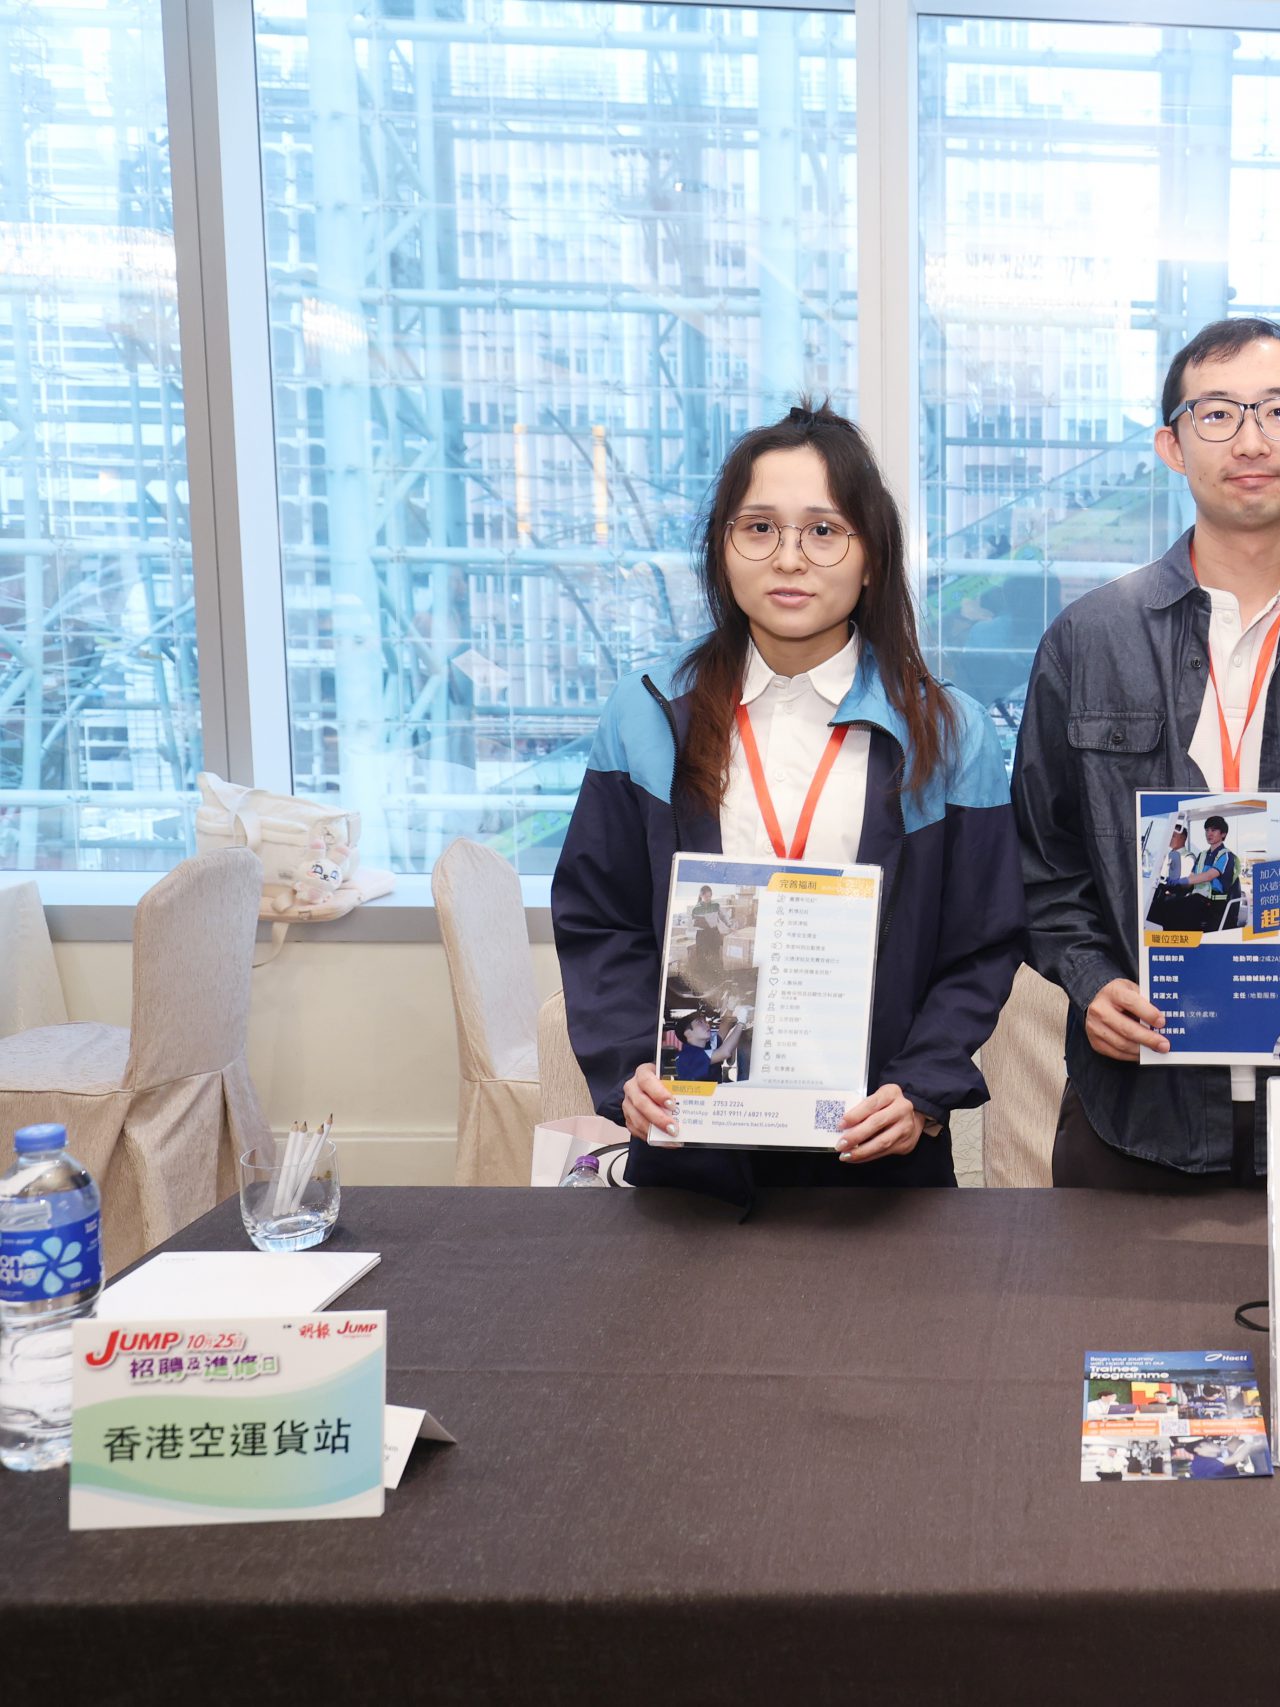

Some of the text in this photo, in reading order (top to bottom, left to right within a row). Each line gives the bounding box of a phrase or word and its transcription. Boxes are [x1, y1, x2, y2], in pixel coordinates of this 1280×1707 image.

[337, 1321, 378, 1334] JUMP
[86, 1329, 179, 1367] JUMP
[130, 1354, 280, 1380] 招聘及進修日
[1090, 1365, 1139, 1373] Trainee
[1090, 1372, 1170, 1380] Programme
[103, 1418, 351, 1462] 香港空運貨站
